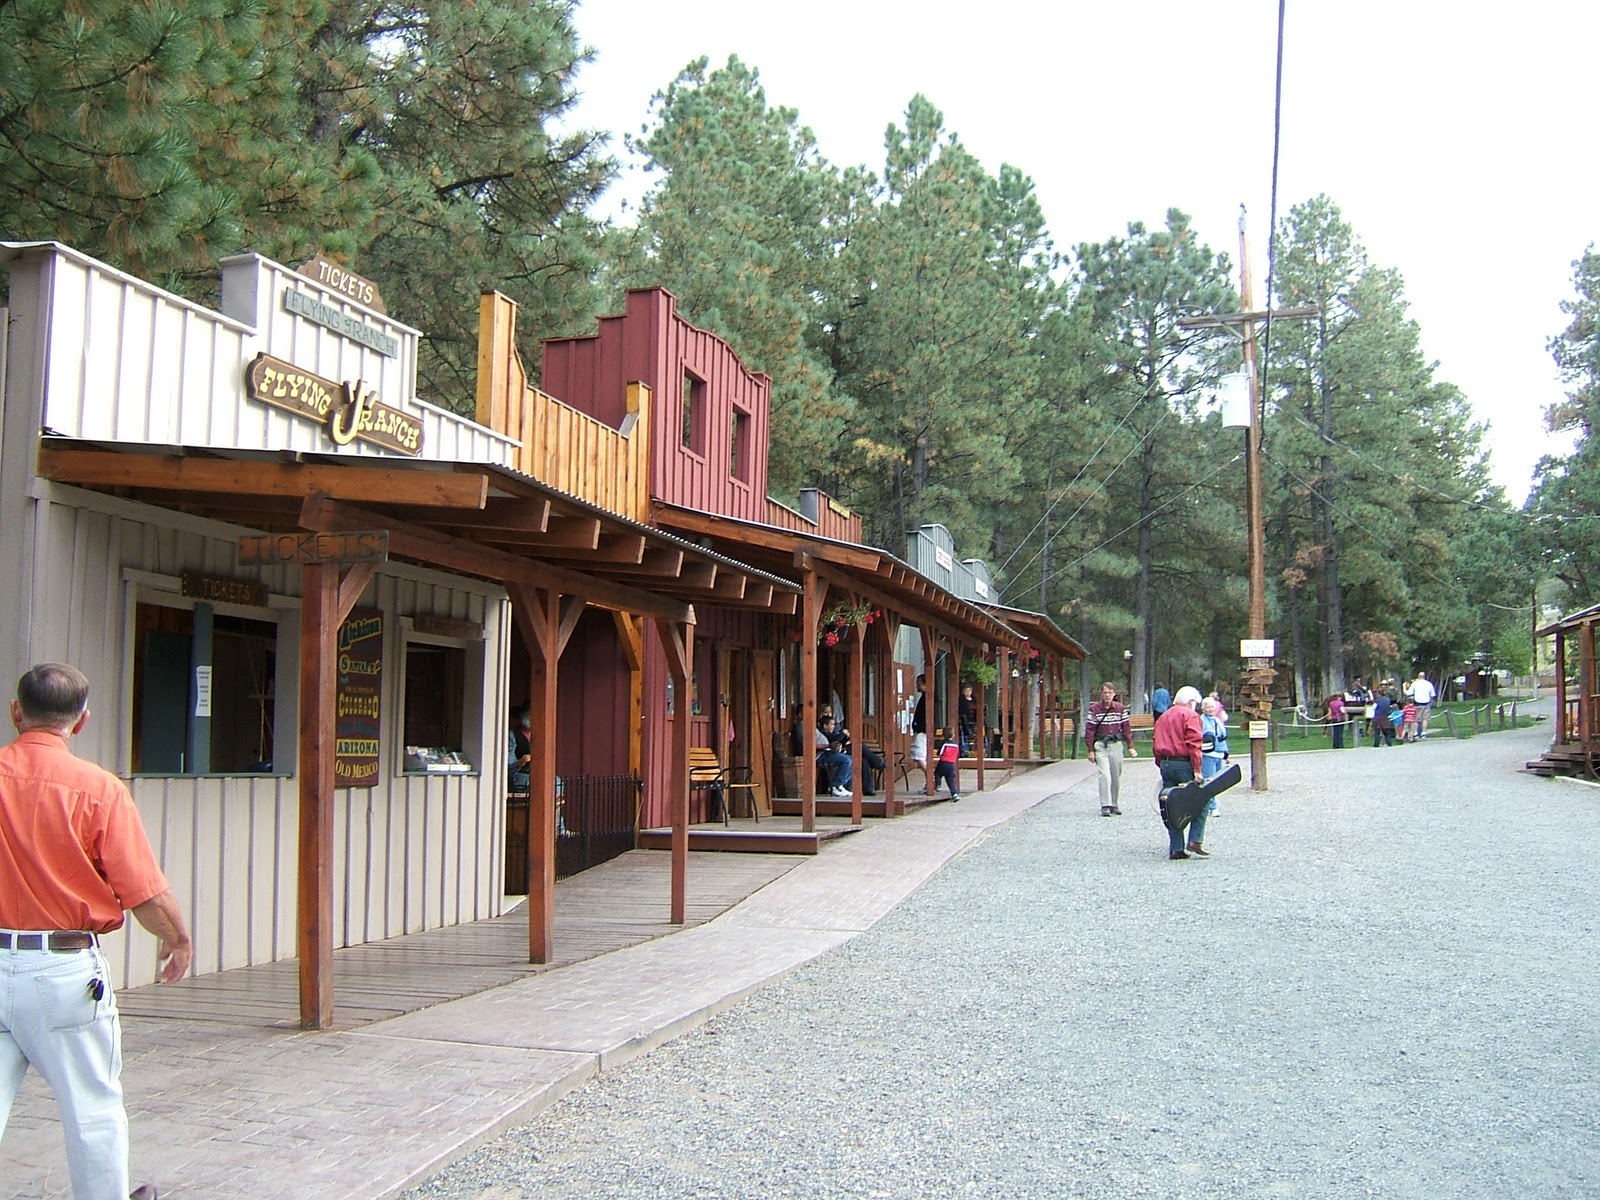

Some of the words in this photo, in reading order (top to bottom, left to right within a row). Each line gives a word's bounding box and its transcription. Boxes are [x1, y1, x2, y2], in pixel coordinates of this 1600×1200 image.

[318, 260, 374, 304] TICKETS
[292, 291, 340, 329] FLYING
[353, 320, 396, 355] RANCH
[259, 366, 332, 416] FLYING
[359, 408, 420, 449] RANCH
[250, 533, 376, 561] TICKETS
[202, 578, 251, 601] TICKETS
[338, 692, 379, 719] COLORADO
[337, 741, 378, 755] ARIZONA
[335, 759, 351, 777] OLD
[352, 761, 378, 778] MEXICO
